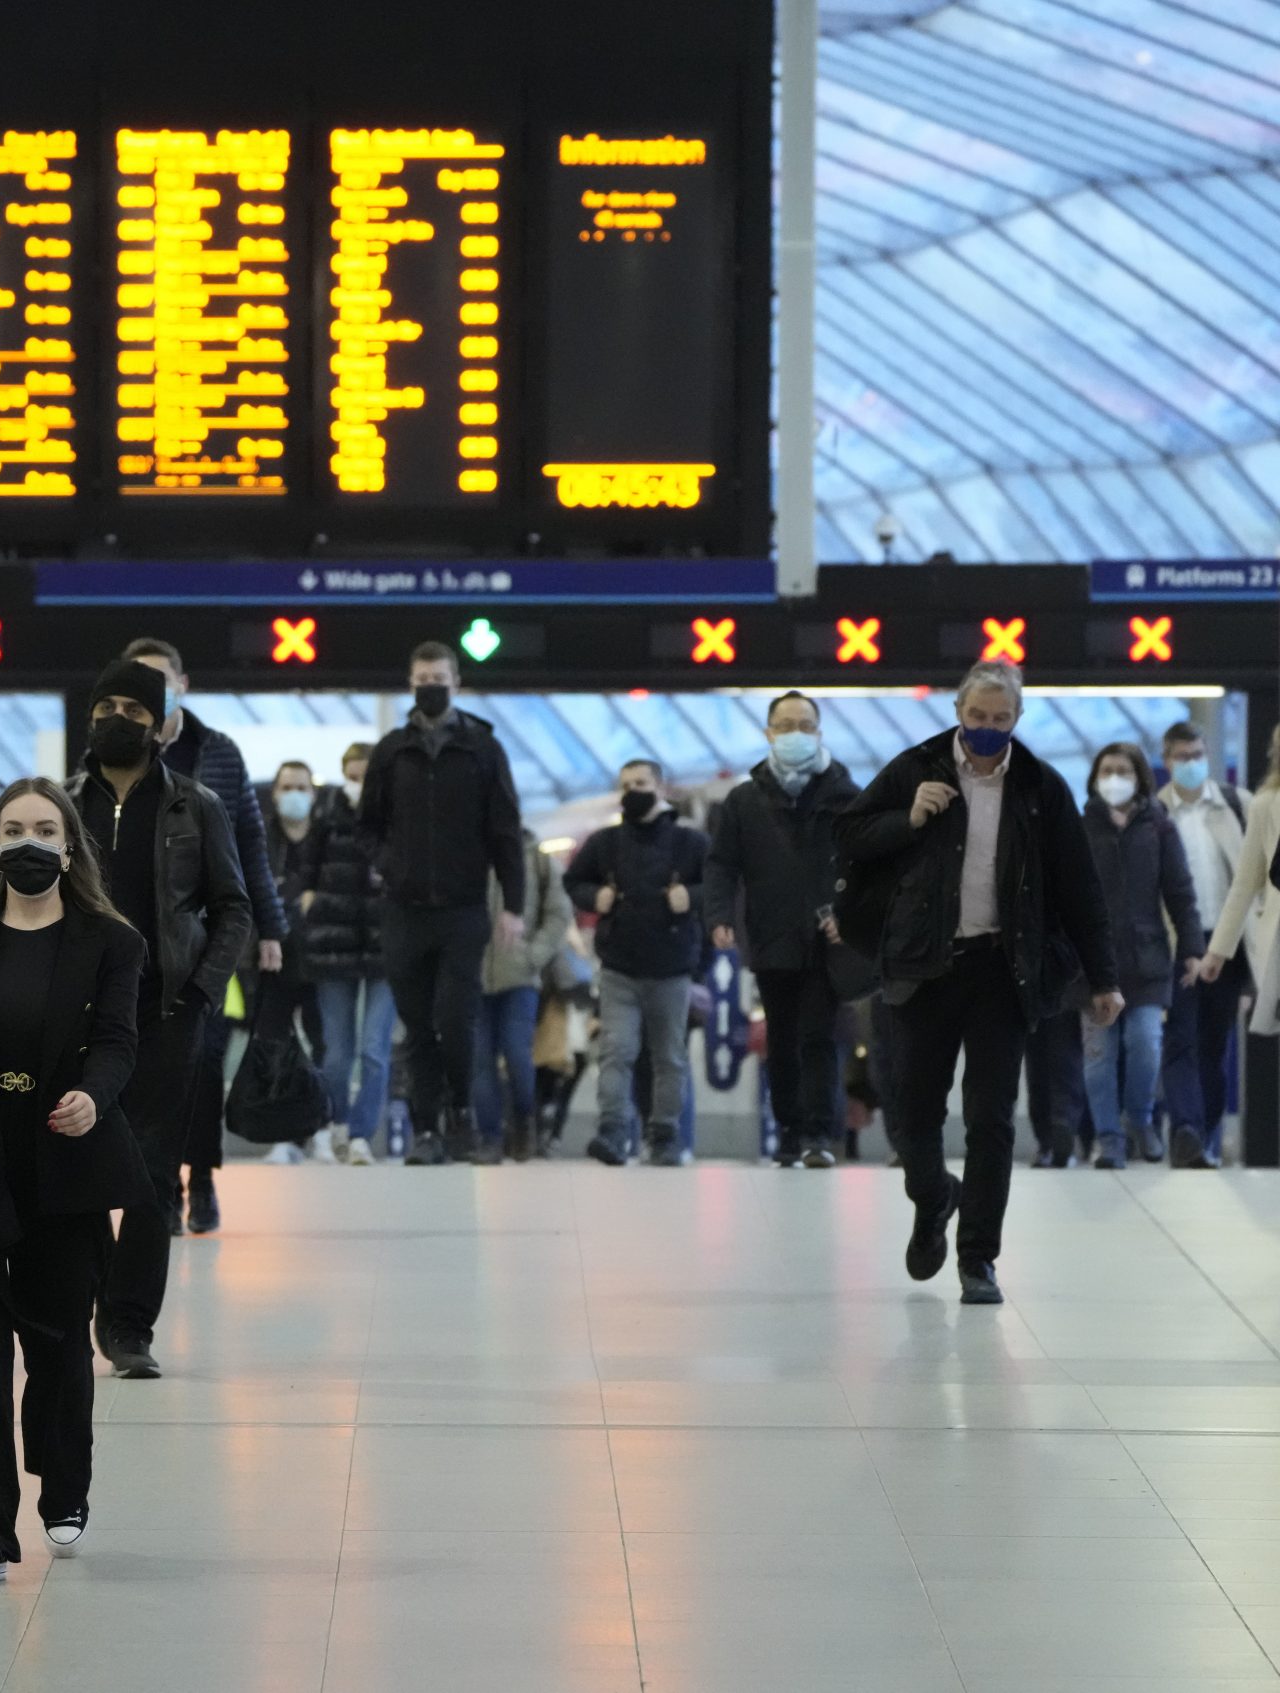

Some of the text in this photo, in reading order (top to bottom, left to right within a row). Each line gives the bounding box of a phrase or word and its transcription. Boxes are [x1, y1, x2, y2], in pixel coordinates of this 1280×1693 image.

[323, 570, 417, 594] Wide gate
[1157, 566, 1246, 588] Platforms
